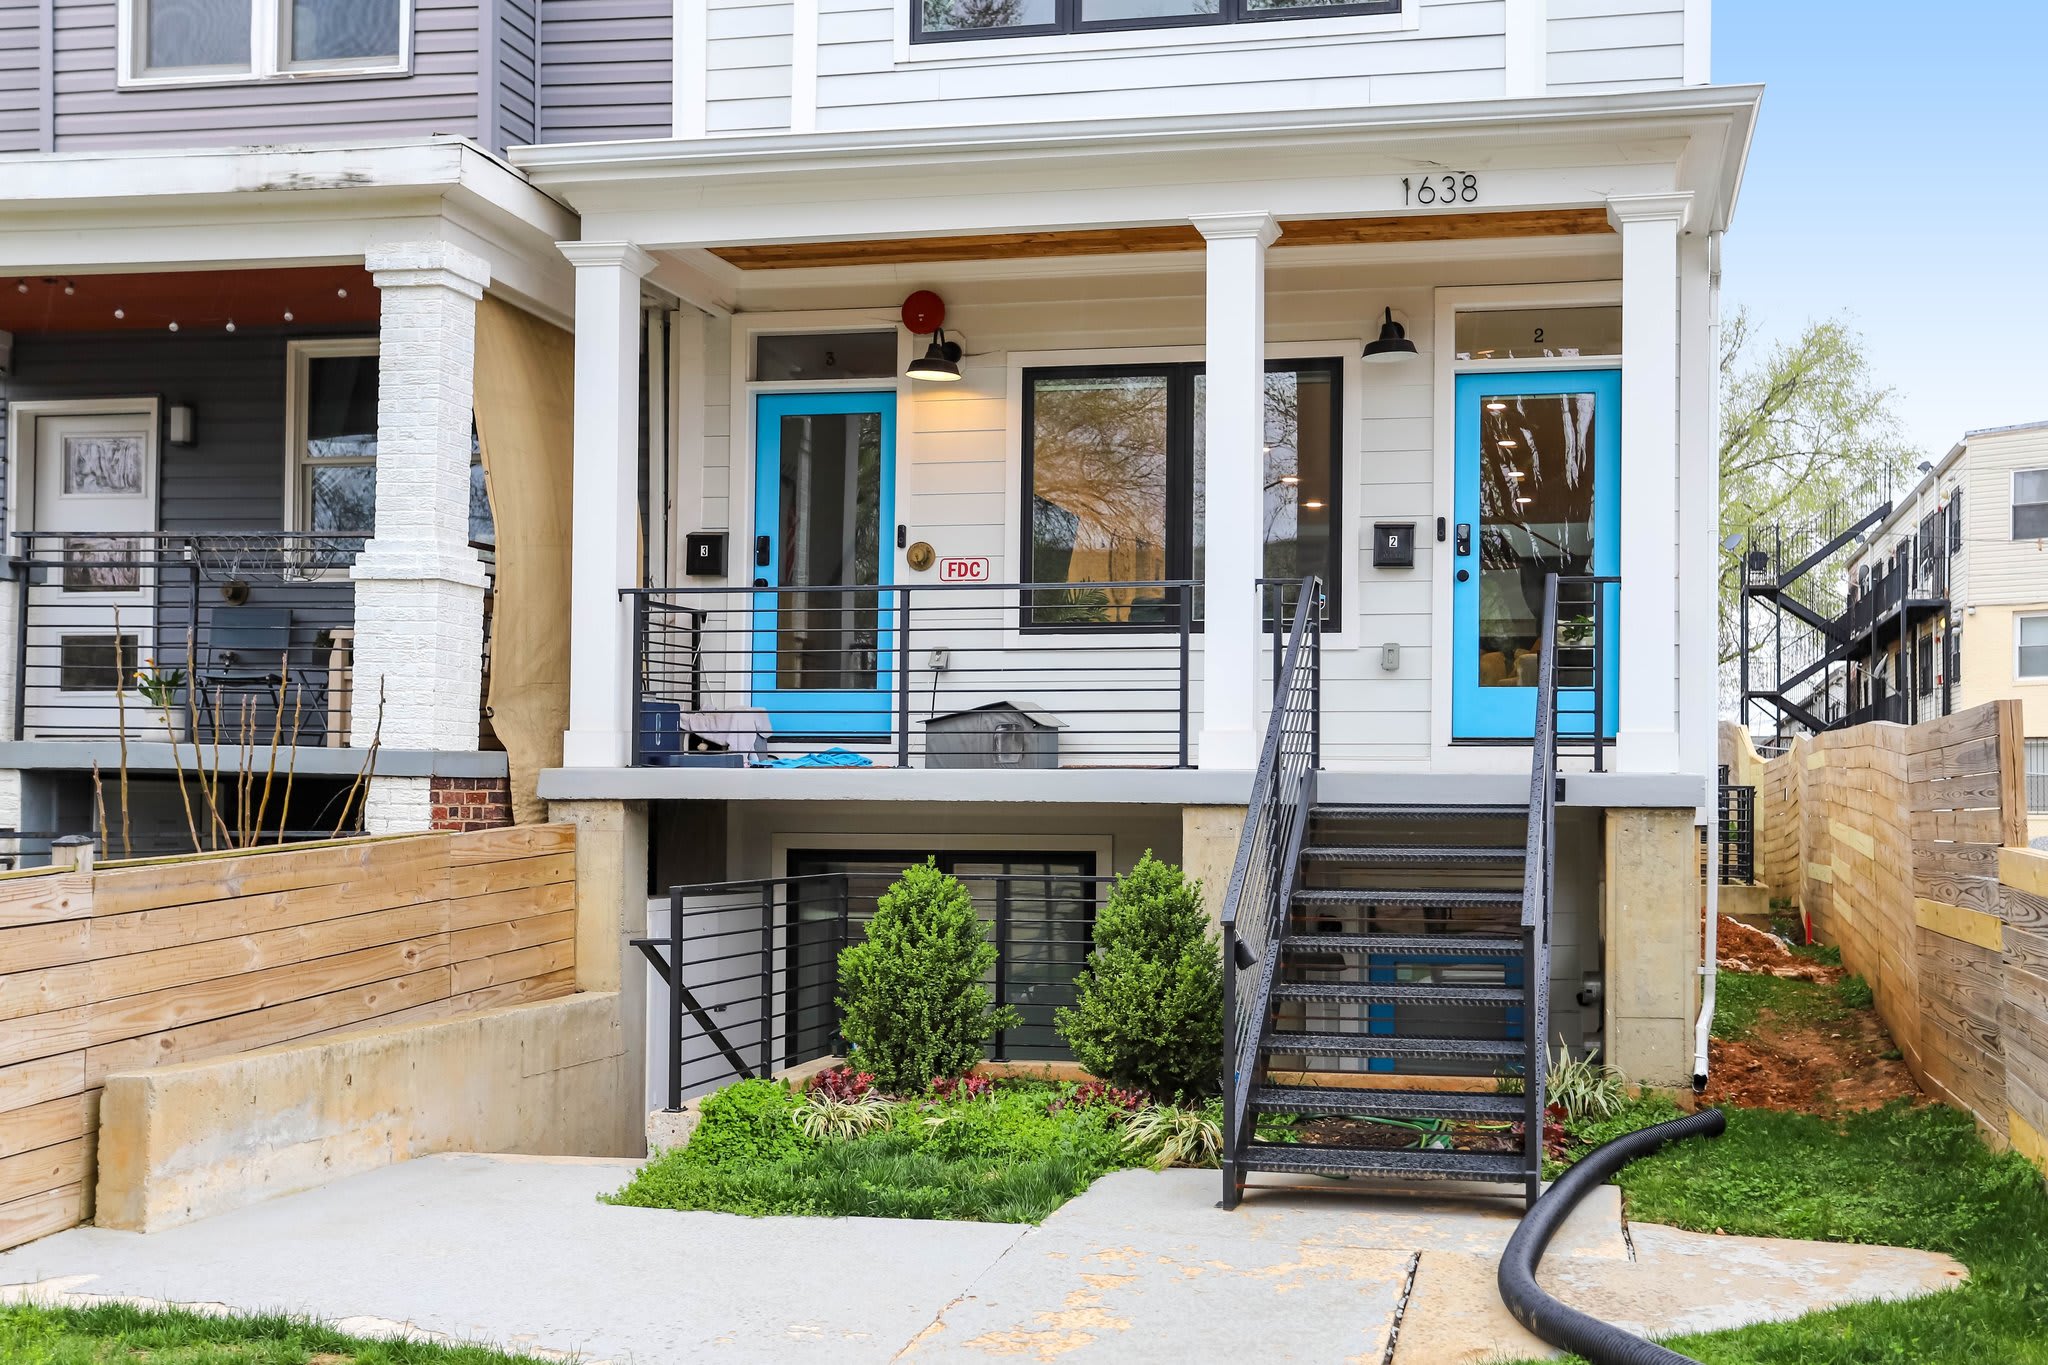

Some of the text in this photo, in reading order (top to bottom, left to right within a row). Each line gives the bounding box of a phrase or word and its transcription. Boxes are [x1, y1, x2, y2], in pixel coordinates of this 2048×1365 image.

[1401, 174, 1478, 206] 1638
[1534, 328, 1544, 343] 2
[825, 351, 836, 367] 3
[1390, 536, 1397, 547] 2
[701, 546, 707, 556] 3
[948, 561, 981, 578] FDC
